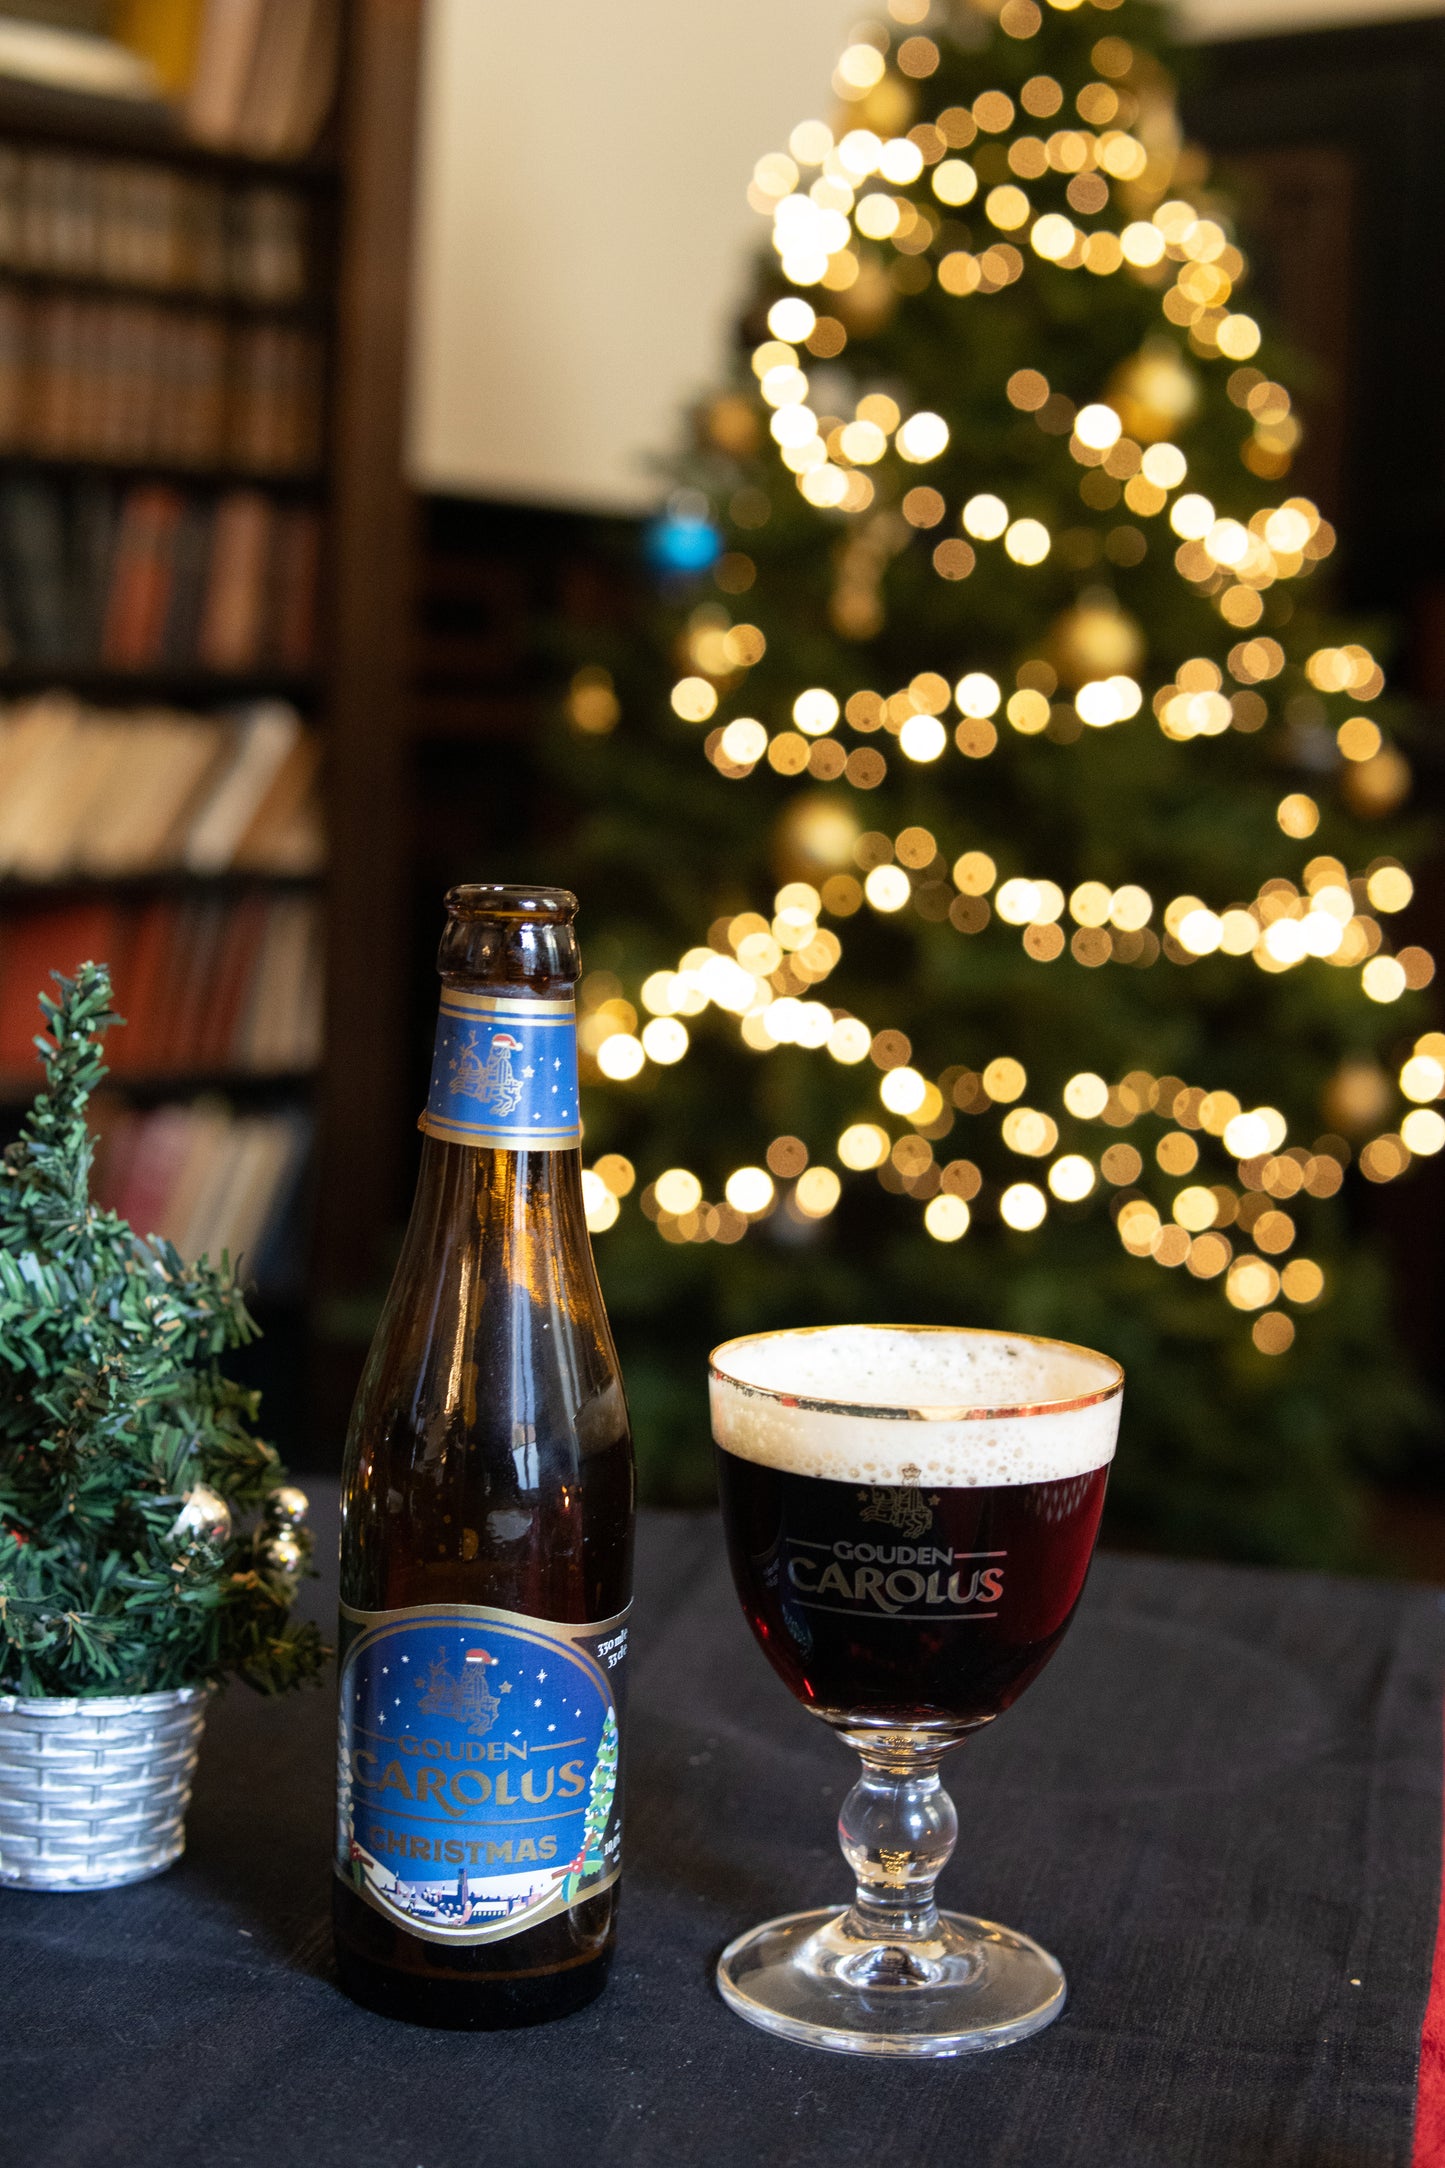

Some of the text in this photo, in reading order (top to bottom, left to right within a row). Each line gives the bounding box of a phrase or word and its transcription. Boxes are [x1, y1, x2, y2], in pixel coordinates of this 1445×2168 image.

[832, 1540, 954, 1566] GOUDEN
[787, 1556, 1005, 1614] CAROLUS
[597, 1639, 614, 1657] 330
[607, 1652, 617, 1669] 33
[397, 1734, 528, 1762] GOUDEN
[351, 1748, 587, 1818] CAROLUS
[369, 1825, 558, 1865] CHRISTMAS
